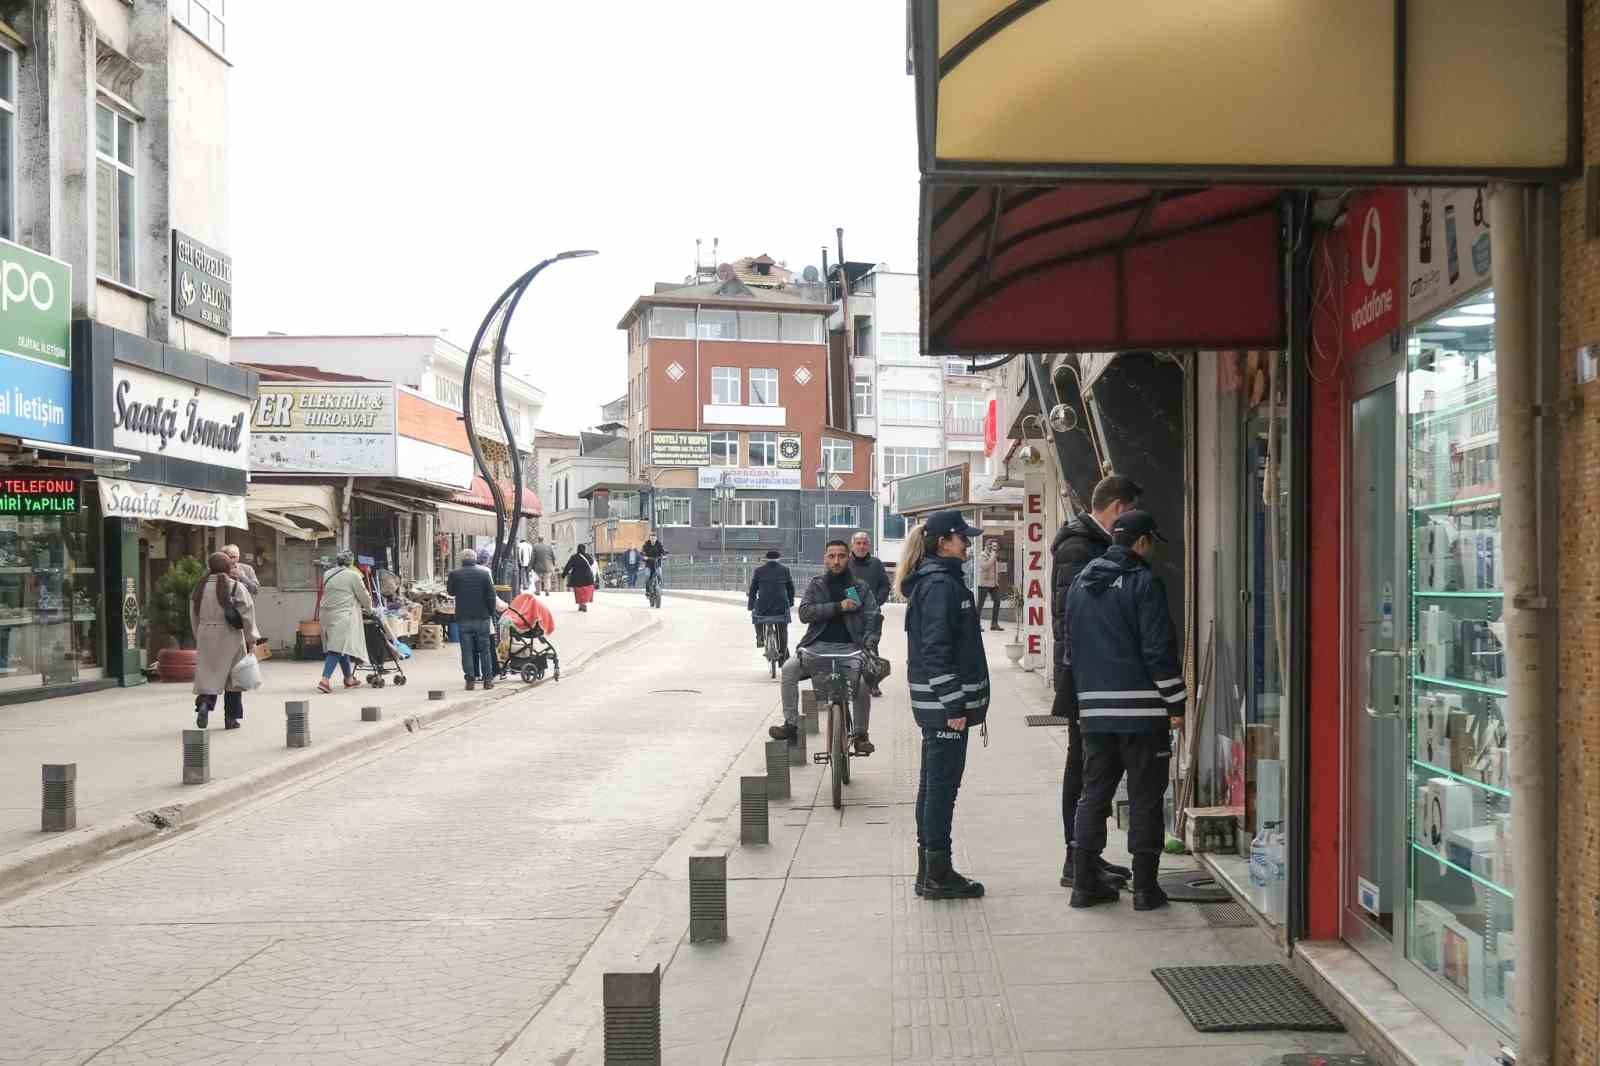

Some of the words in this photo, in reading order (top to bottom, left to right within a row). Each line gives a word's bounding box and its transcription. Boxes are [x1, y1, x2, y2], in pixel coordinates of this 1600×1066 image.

[0, 260, 53, 311] po
[201, 282, 231, 312] SALONU
[1351, 288, 1393, 332] vodafone
[15, 386, 64, 427] İletişim
[112, 380, 177, 451] Saatçi
[181, 388, 245, 453] İsmail
[250, 393, 294, 427] ER
[299, 391, 368, 409] ELEKTRİK
[368, 392, 384, 410] &
[305, 412, 377, 427] HIRDAVAT
[5, 480, 74, 493] TELEFONU
[24, 497, 75, 511] YAPILIR
[165, 488, 220, 520] İsmail
[1027, 494, 1044, 654] ECZANE
